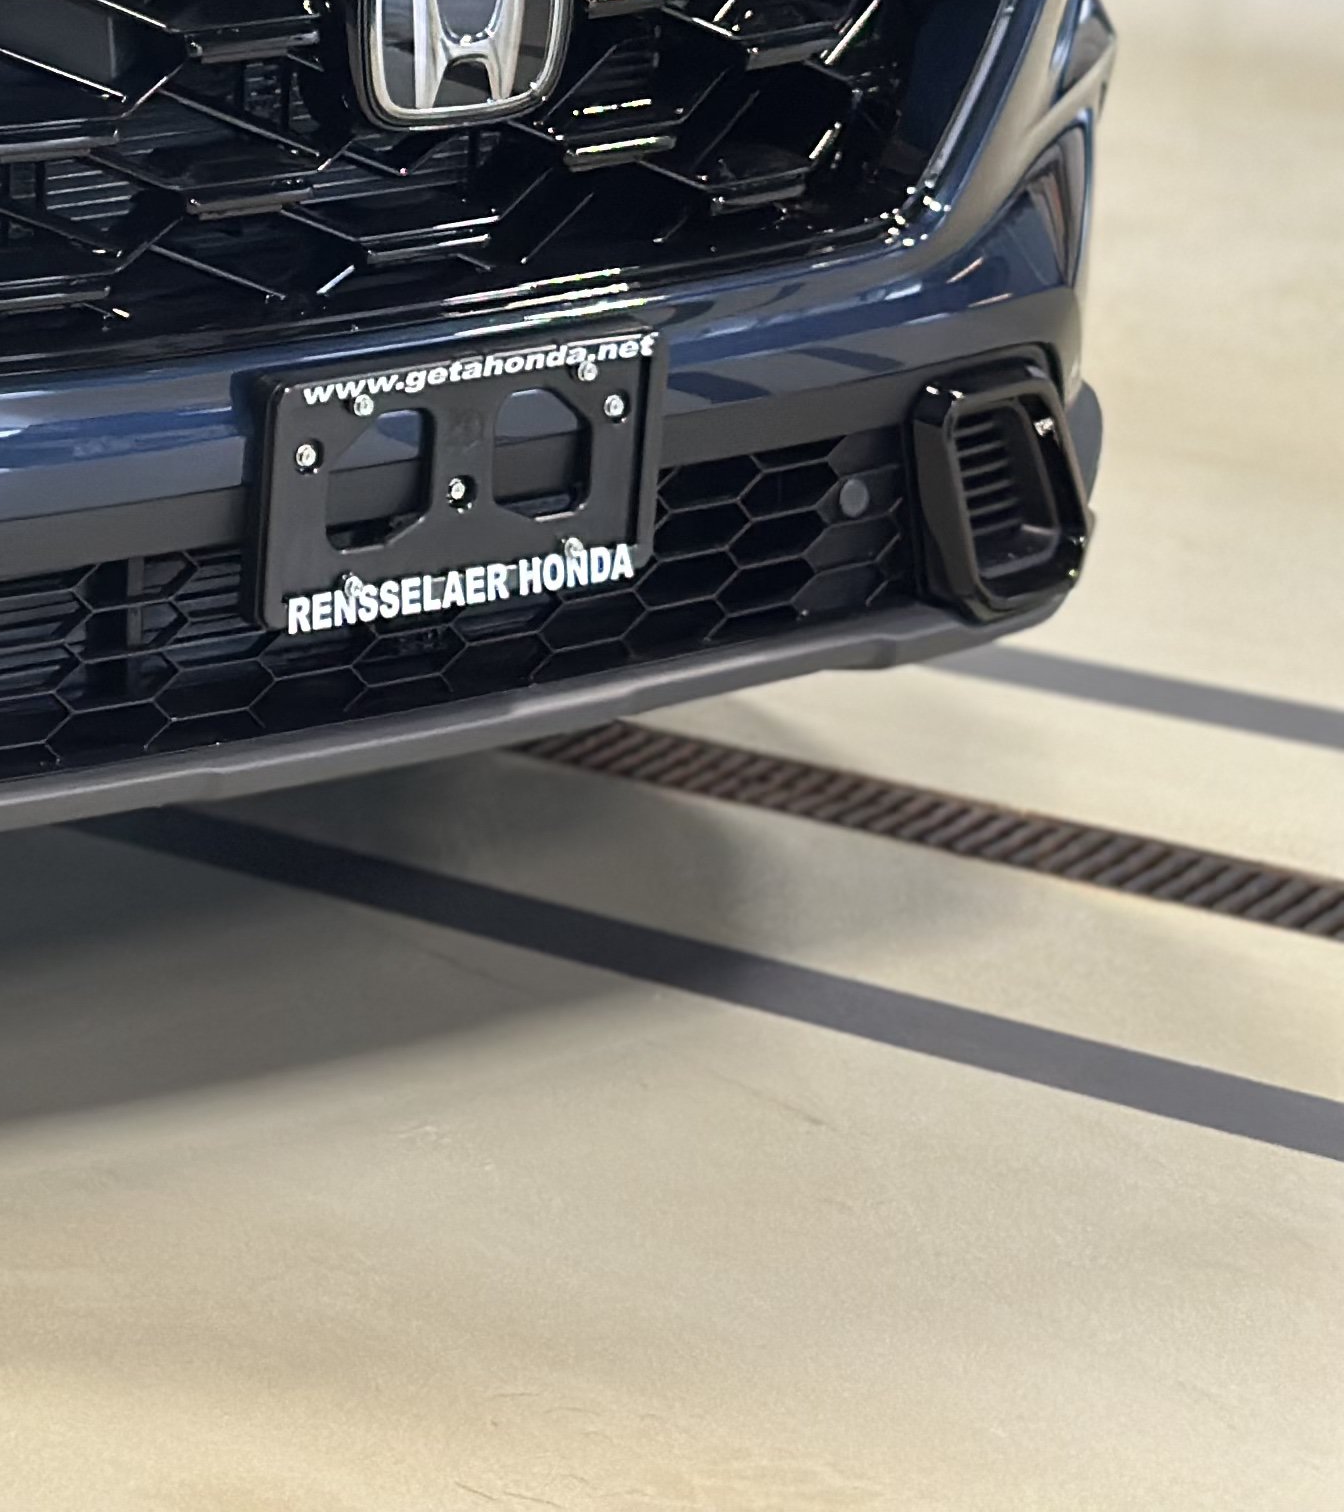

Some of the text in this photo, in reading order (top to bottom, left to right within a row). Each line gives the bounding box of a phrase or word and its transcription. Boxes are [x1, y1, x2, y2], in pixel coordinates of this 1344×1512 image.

[303, 331, 659, 405] www.getahonda.net
[287, 543, 635, 635] RENSSELAER HONDA
